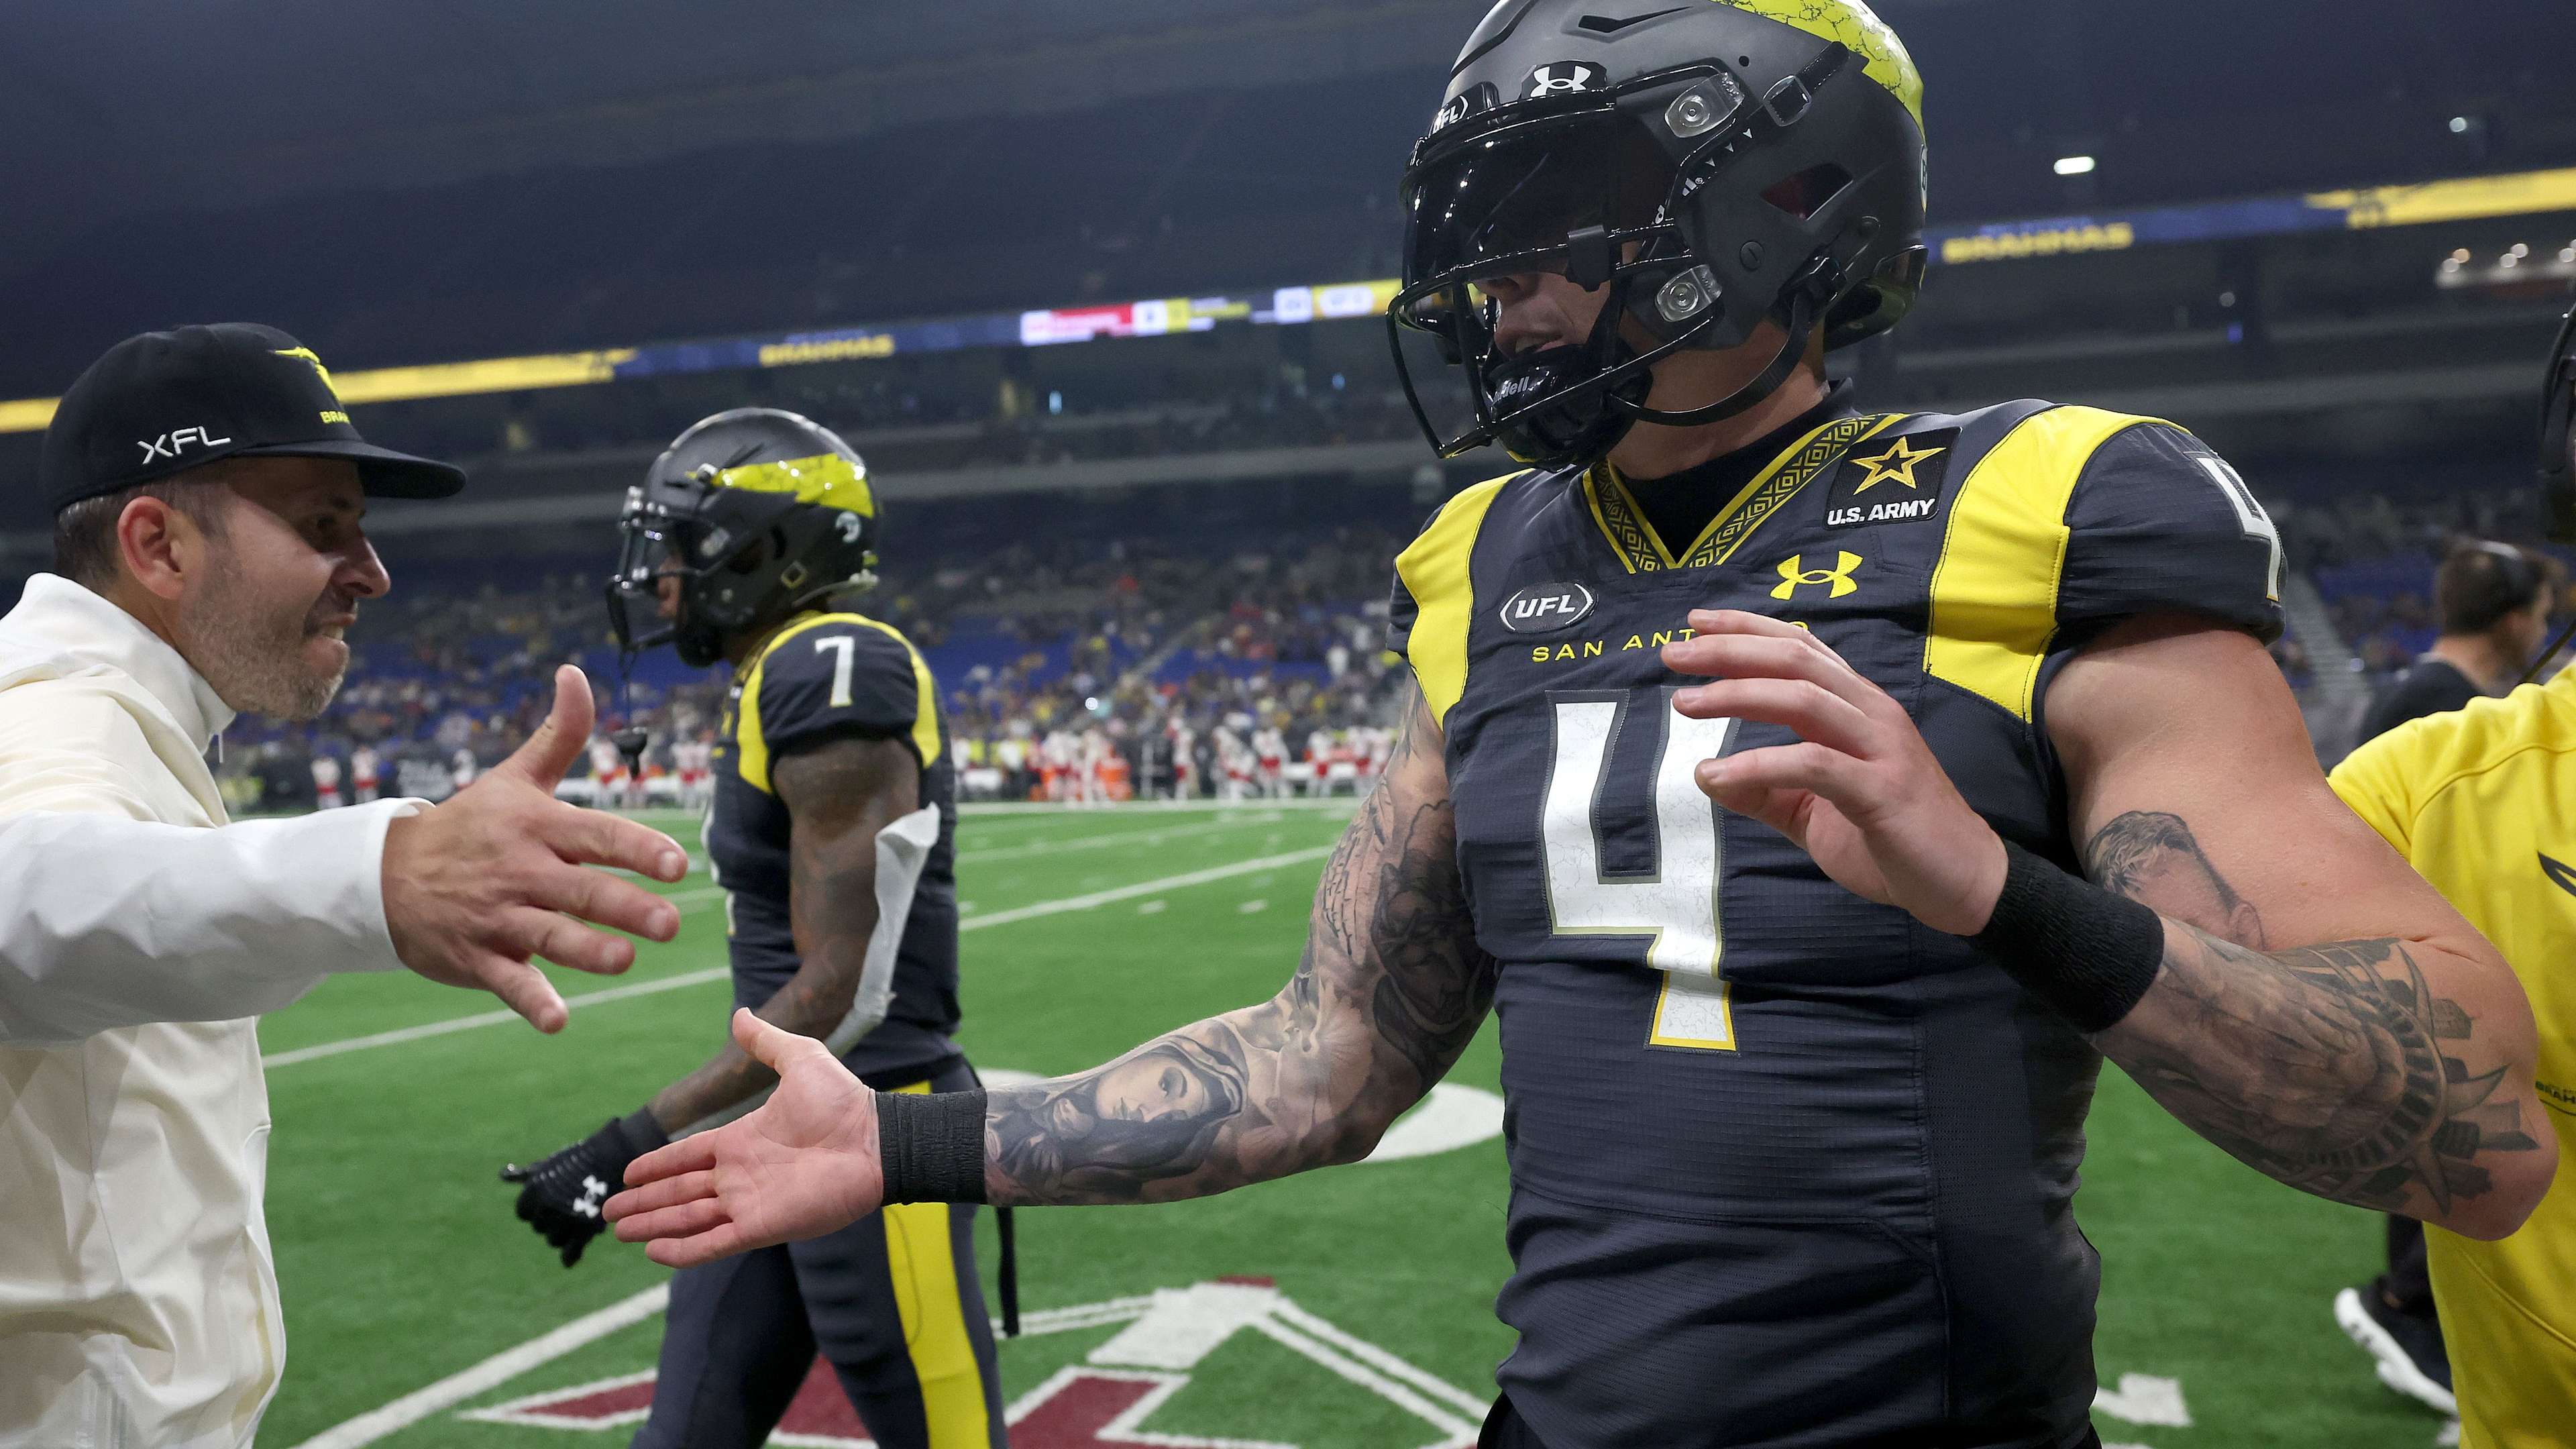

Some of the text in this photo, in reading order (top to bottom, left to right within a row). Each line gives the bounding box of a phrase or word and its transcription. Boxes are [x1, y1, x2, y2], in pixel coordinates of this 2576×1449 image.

[137, 425, 231, 466] XFL
[1827, 498, 1935, 525] U.S. ARMY
[2196, 456, 2279, 602] 4
[1515, 594, 1576, 619] UFL
[814, 635, 855, 708] 7
[1532, 640, 1604, 663] SAN
[1541, 698, 1737, 1053] 4
